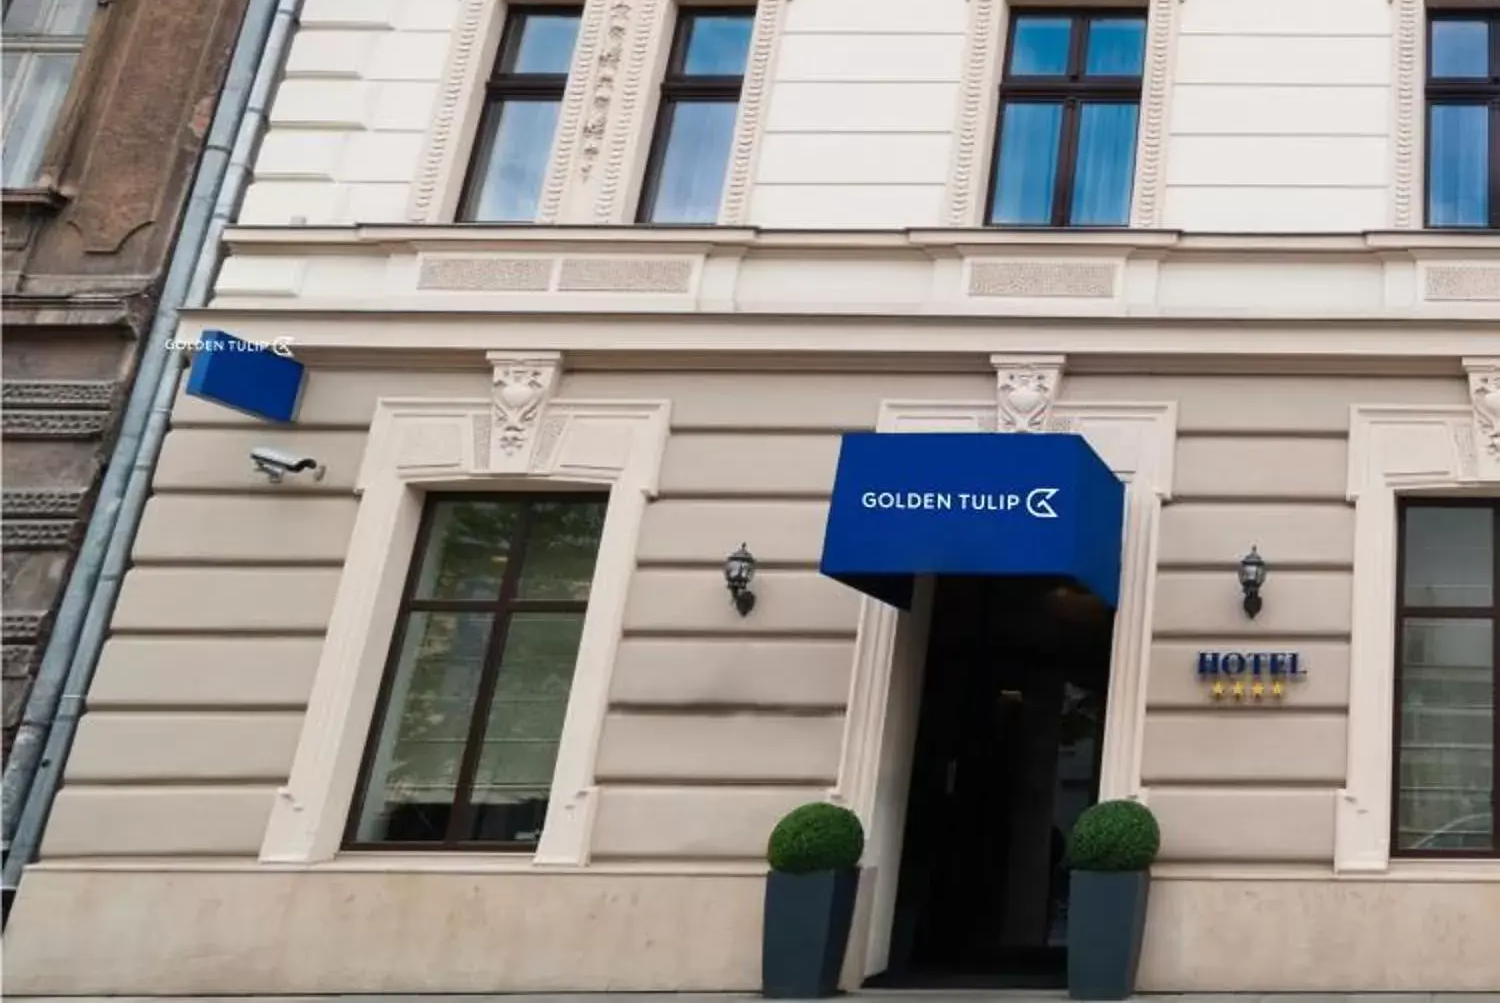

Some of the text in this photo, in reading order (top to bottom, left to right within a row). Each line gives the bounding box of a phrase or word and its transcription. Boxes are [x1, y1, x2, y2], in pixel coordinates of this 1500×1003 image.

[164, 340, 271, 353] GOLDEN TULIP
[861, 491, 1020, 511] GOLDEN TULIP
[1197, 651, 1308, 675] HOTEL
